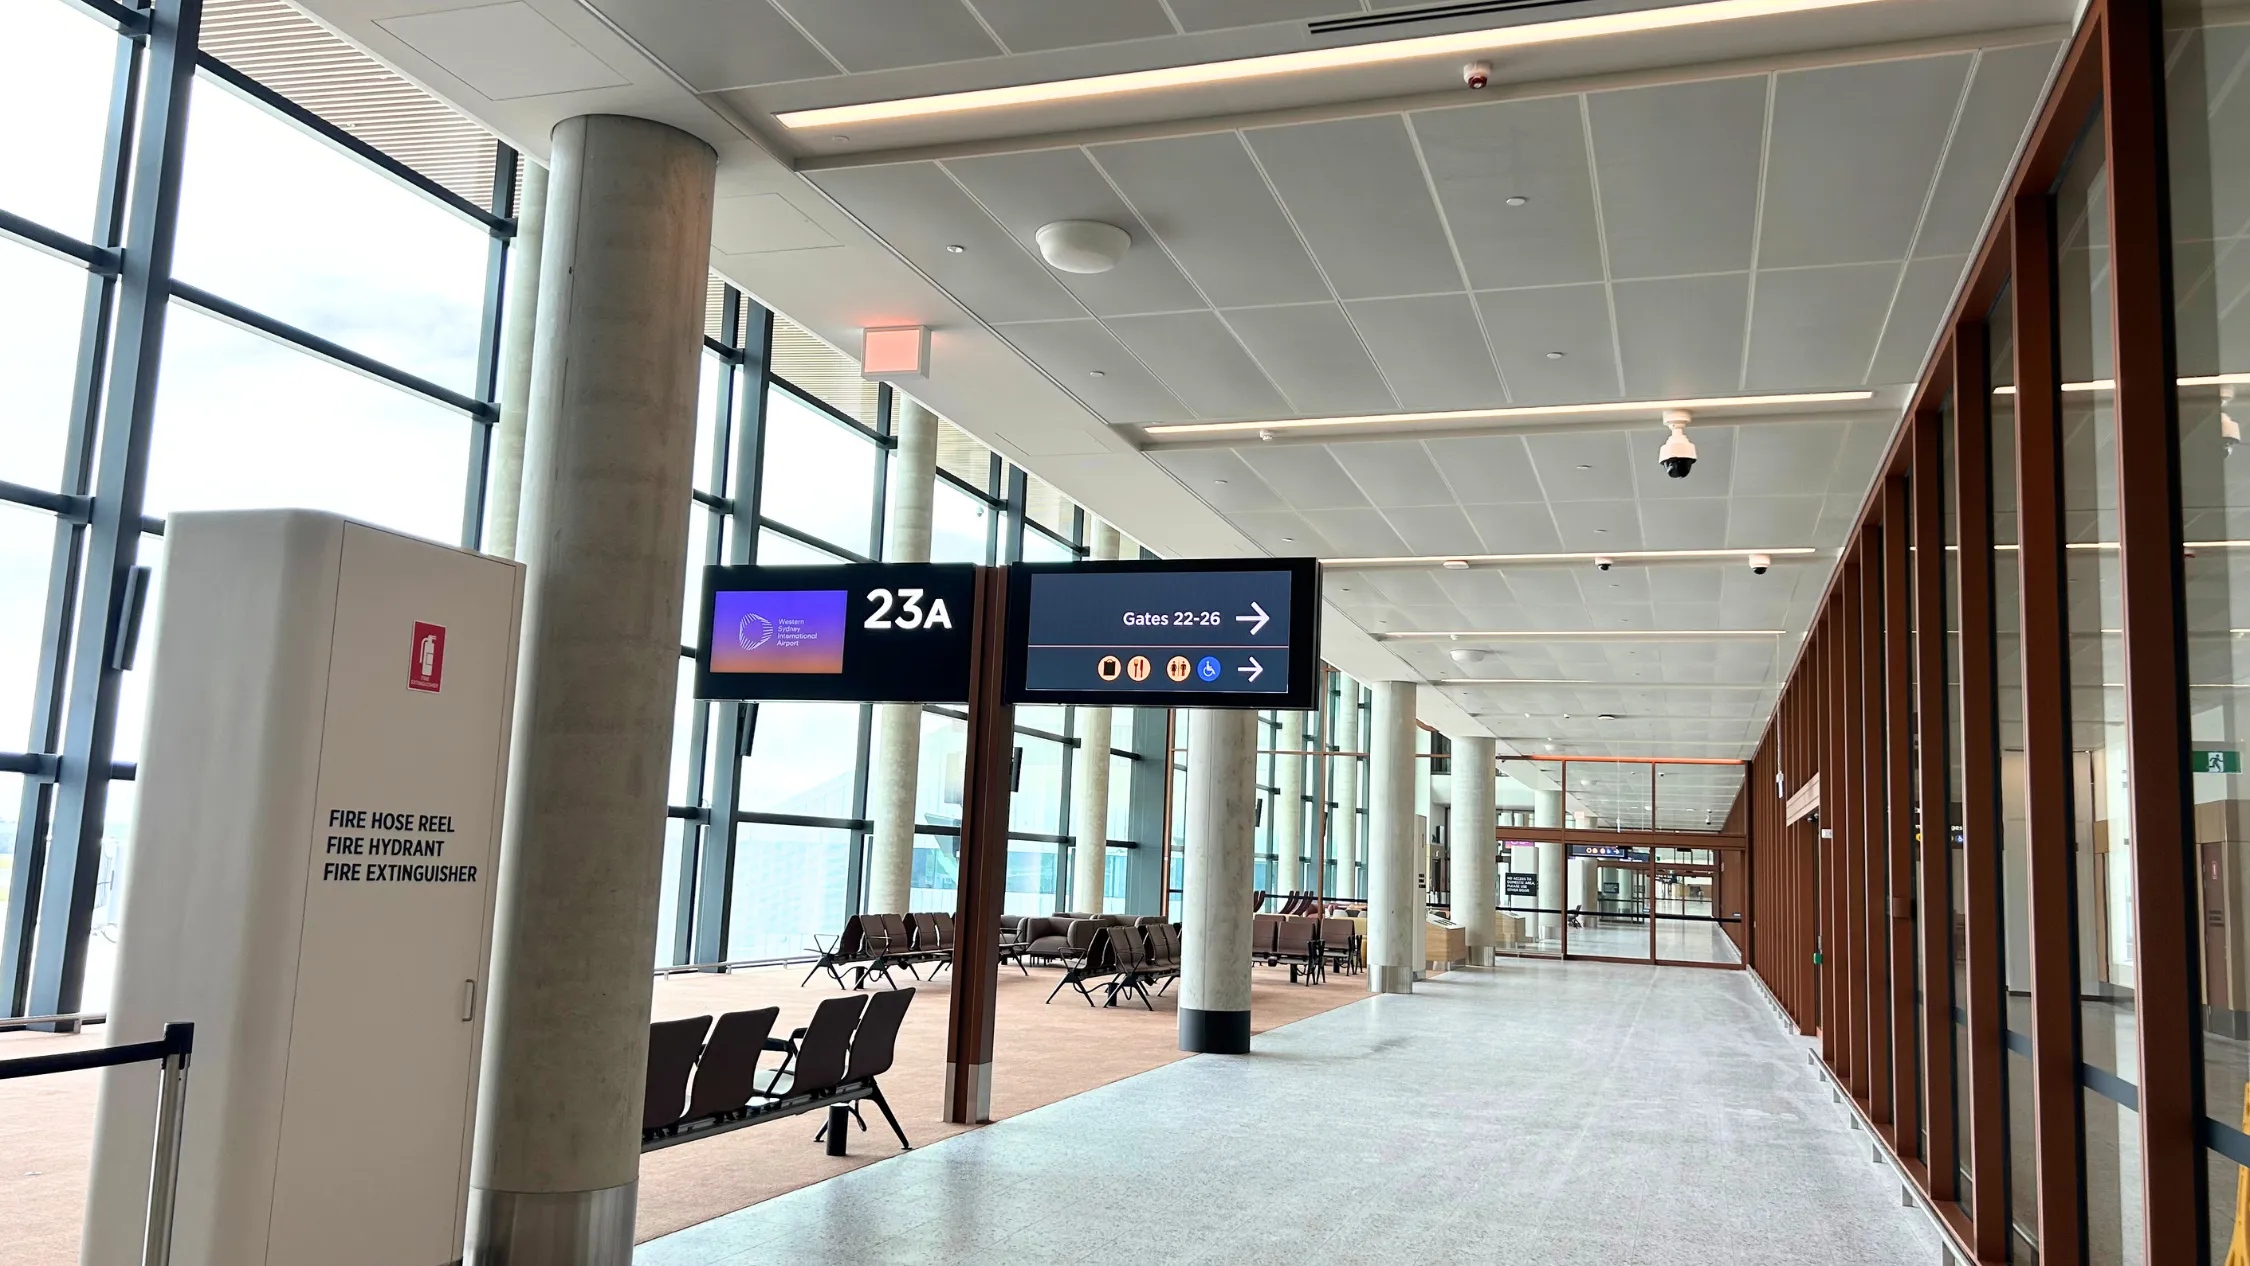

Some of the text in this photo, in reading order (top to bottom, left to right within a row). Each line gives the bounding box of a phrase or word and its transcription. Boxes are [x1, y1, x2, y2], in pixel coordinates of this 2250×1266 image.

[864, 588, 952, 629] 23A
[1123, 612, 1221, 626] Gates 22-26
[777, 625, 801, 633] Sydney
[777, 632, 818, 640] International
[329, 809, 455, 833] FIRE HOSE REEL
[326, 836, 444, 857] FIRE HYDRANT
[323, 863, 477, 882] FIRE EXTINGUISHER
